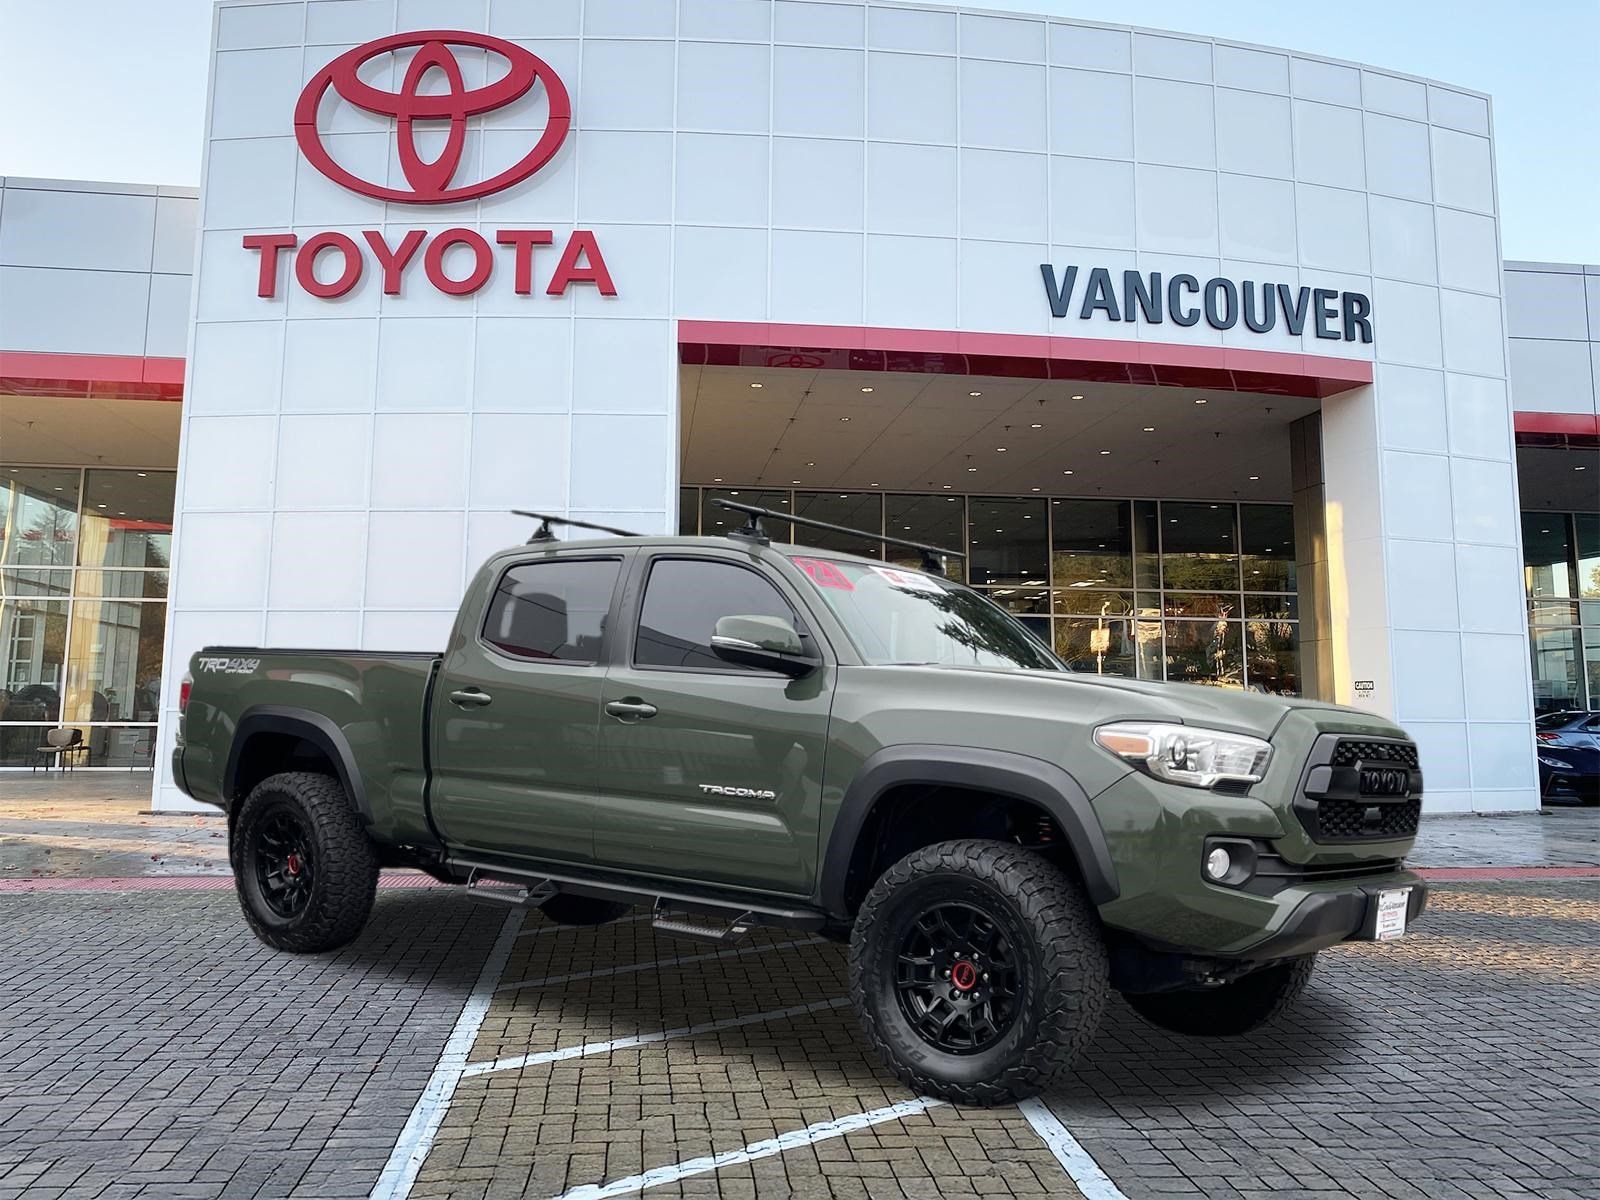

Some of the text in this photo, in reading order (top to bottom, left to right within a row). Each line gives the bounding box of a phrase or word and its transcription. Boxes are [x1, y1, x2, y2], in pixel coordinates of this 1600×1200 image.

[242, 228, 618, 299] TOYOTA
[1040, 264, 1373, 343] VANCOUVER
[199, 657, 229, 673] TRD
[699, 784, 776, 800] TACOMA
[1360, 770, 1407, 792] TOYOTA
